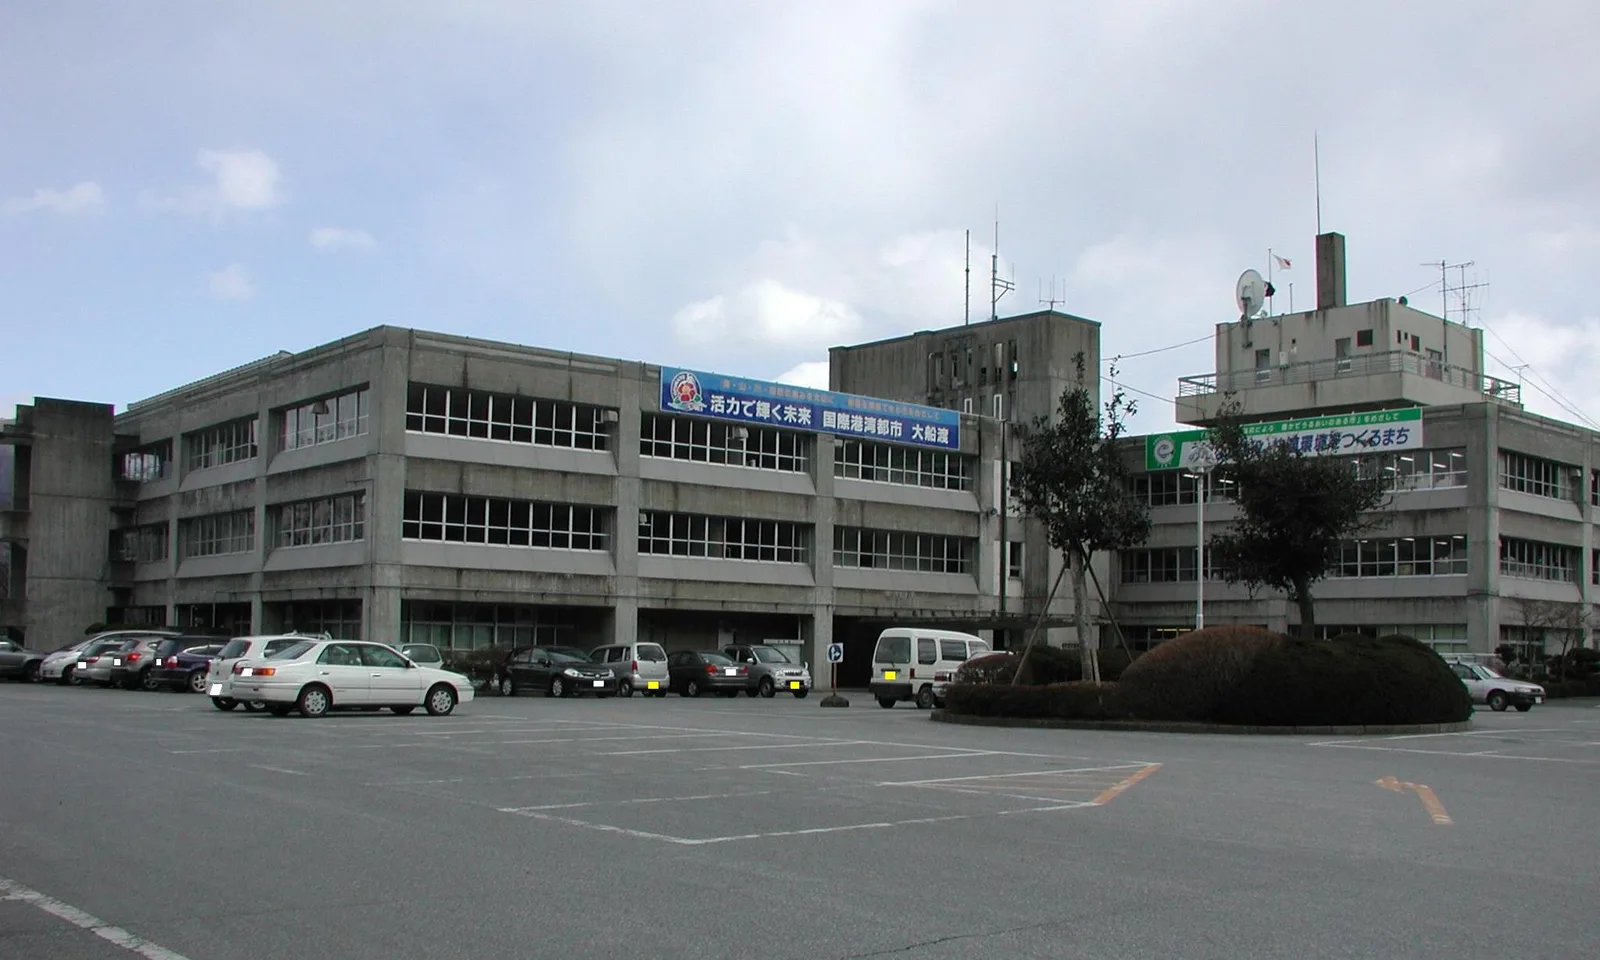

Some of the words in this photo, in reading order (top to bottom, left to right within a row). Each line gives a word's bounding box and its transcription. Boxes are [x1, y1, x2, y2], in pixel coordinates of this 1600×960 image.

[710, 394, 812, 425] 活力で輝く未来
[823, 410, 903, 438] 国際港湾都市
[911, 423, 949, 444] 大船渡
